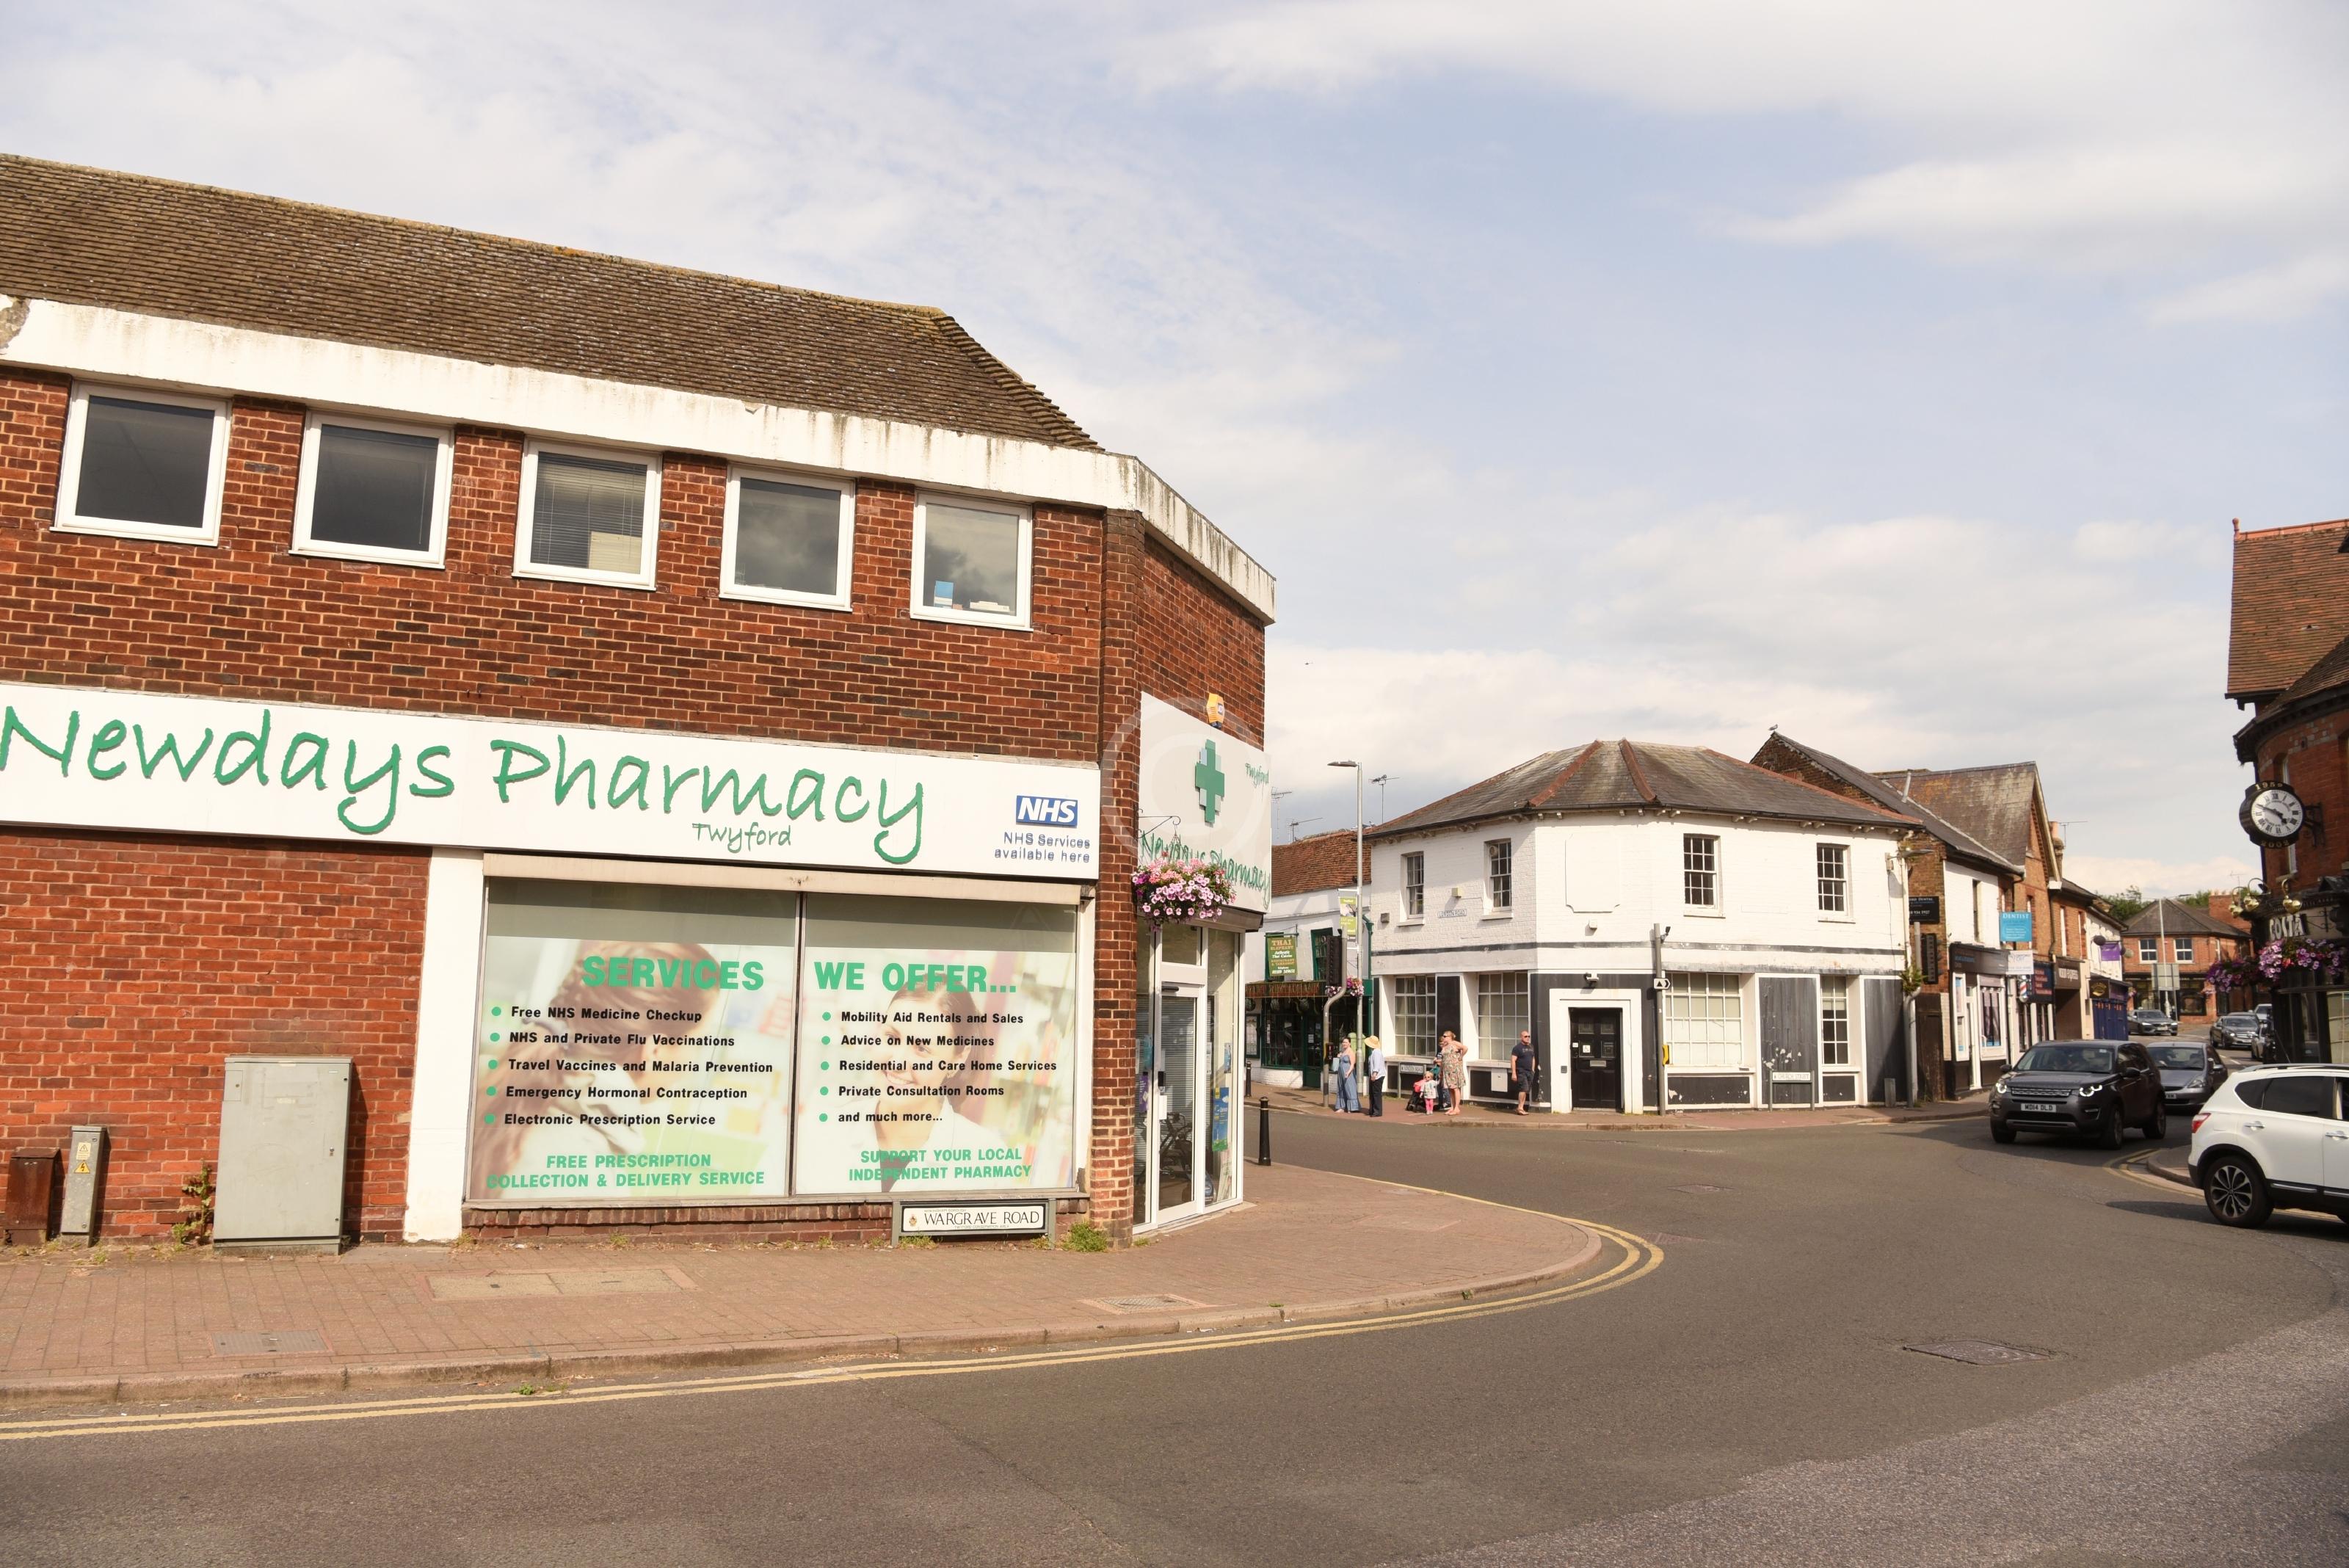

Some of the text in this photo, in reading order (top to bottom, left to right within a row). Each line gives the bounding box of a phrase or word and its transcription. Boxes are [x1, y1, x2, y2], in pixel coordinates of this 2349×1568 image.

[1245, 763, 1270, 788] Twyford
[0, 705, 923, 865] Newdays Pharmacy
[1017, 797, 1077, 823] NHS
[691, 822, 792, 854] Twyford
[1003, 832, 1091, 849] NHS Services
[994, 847, 1091, 863] available here
[2269, 913, 2304, 940] COSTA
[582, 956, 764, 990] SERVICES
[814, 962, 1017, 993] WE OFFER...
[512, 1006, 702, 1023] Free NHS Medicine Checkup
[841, 1012, 1024, 1024] Mobility Aid Rentals and Sales
[509, 1032, 735, 1047] NHS and Private Flu Vaccinations
[841, 1035, 995, 1047] Advice on New Medicines
[509, 1059, 773, 1073] Travel Vaccines and Malaria Prevention
[839, 1060, 1057, 1071] Residential and Care Home Services
[506, 1086, 747, 1100] Emergency Hormonal Contraception
[838, 1086, 1004, 1097] Private Consultation Rooms
[504, 1114, 716, 1127] Electronic Prescription Service
[838, 1111, 943, 1122] and much more...
[546, 1154, 711, 1169] FREE PRESCRIPTION
[860, 1148, 1022, 1163] SUPPORT YOUR LOCAL
[486, 1172, 764, 1188] COLLECTION & DELIVERY SERVICE
[849, 1165, 1032, 1181] INDEPENDENT PHARMACY
[924, 1211, 1040, 1225] WARGRAVE ROAD
